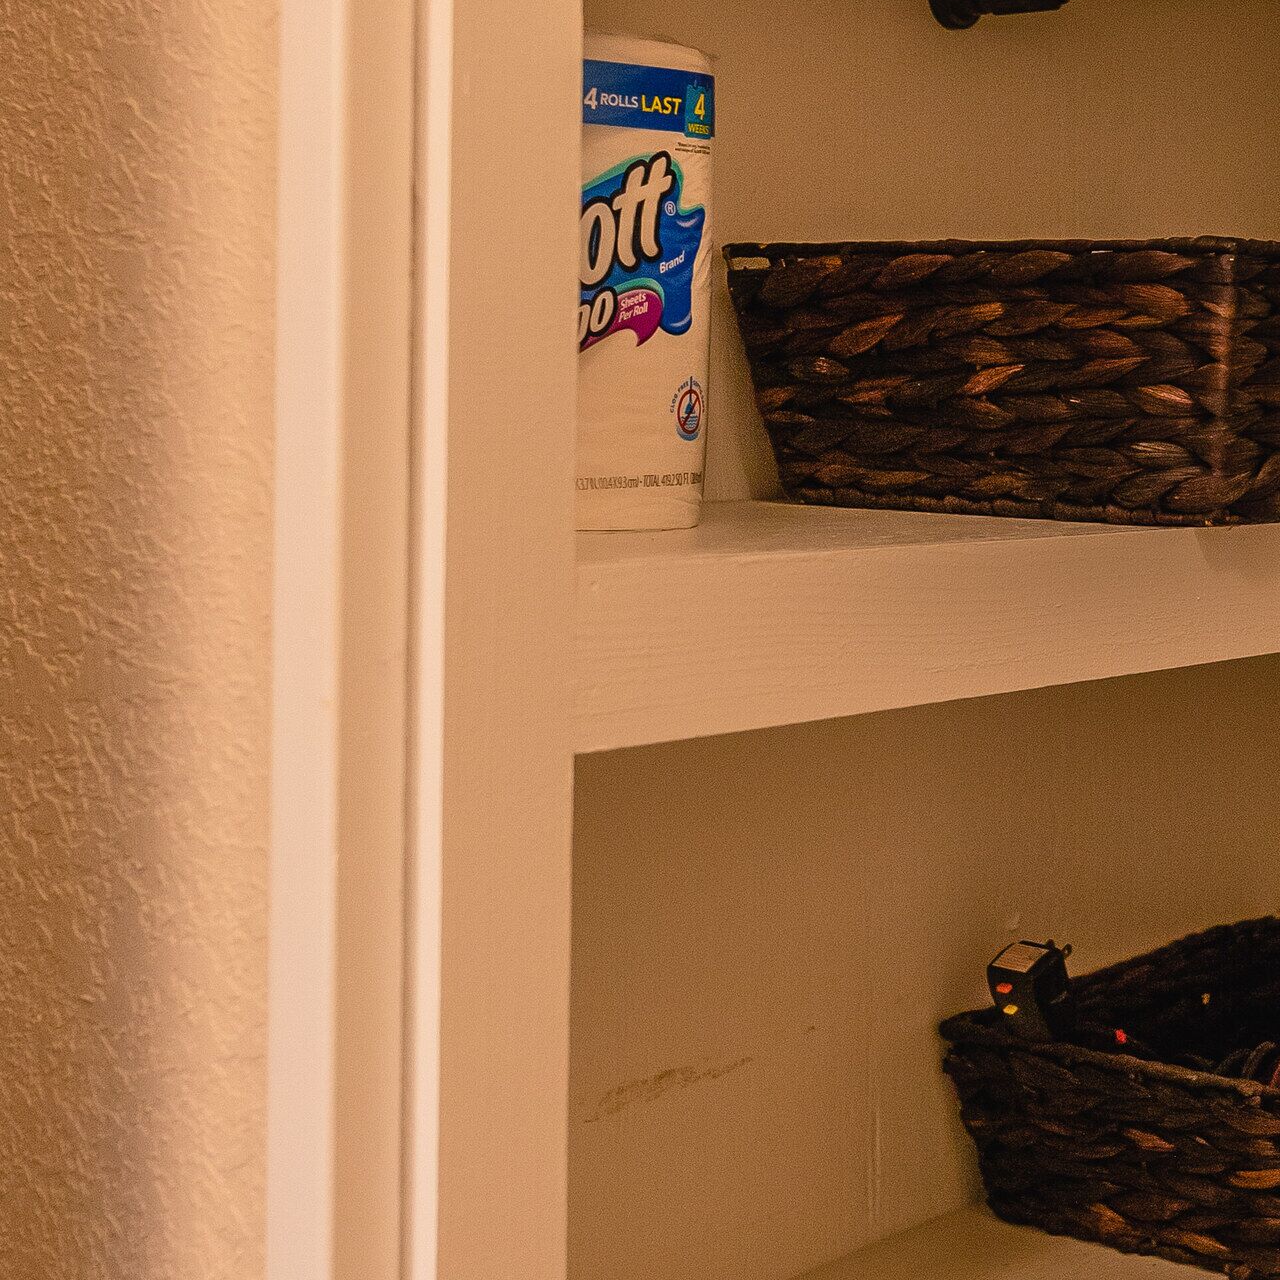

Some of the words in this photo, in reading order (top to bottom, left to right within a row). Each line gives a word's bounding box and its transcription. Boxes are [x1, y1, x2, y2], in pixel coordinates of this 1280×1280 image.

[583, 87, 598, 110] 4
[600, 93, 639, 108] ROLLS
[641, 94, 682, 115] LAST
[694, 93, 705, 121] 4
[659, 250, 685, 274] Brand
[618, 309, 633, 323] Per
[633, 301, 648, 317] Roll
[620, 292, 647, 311] Sheets
